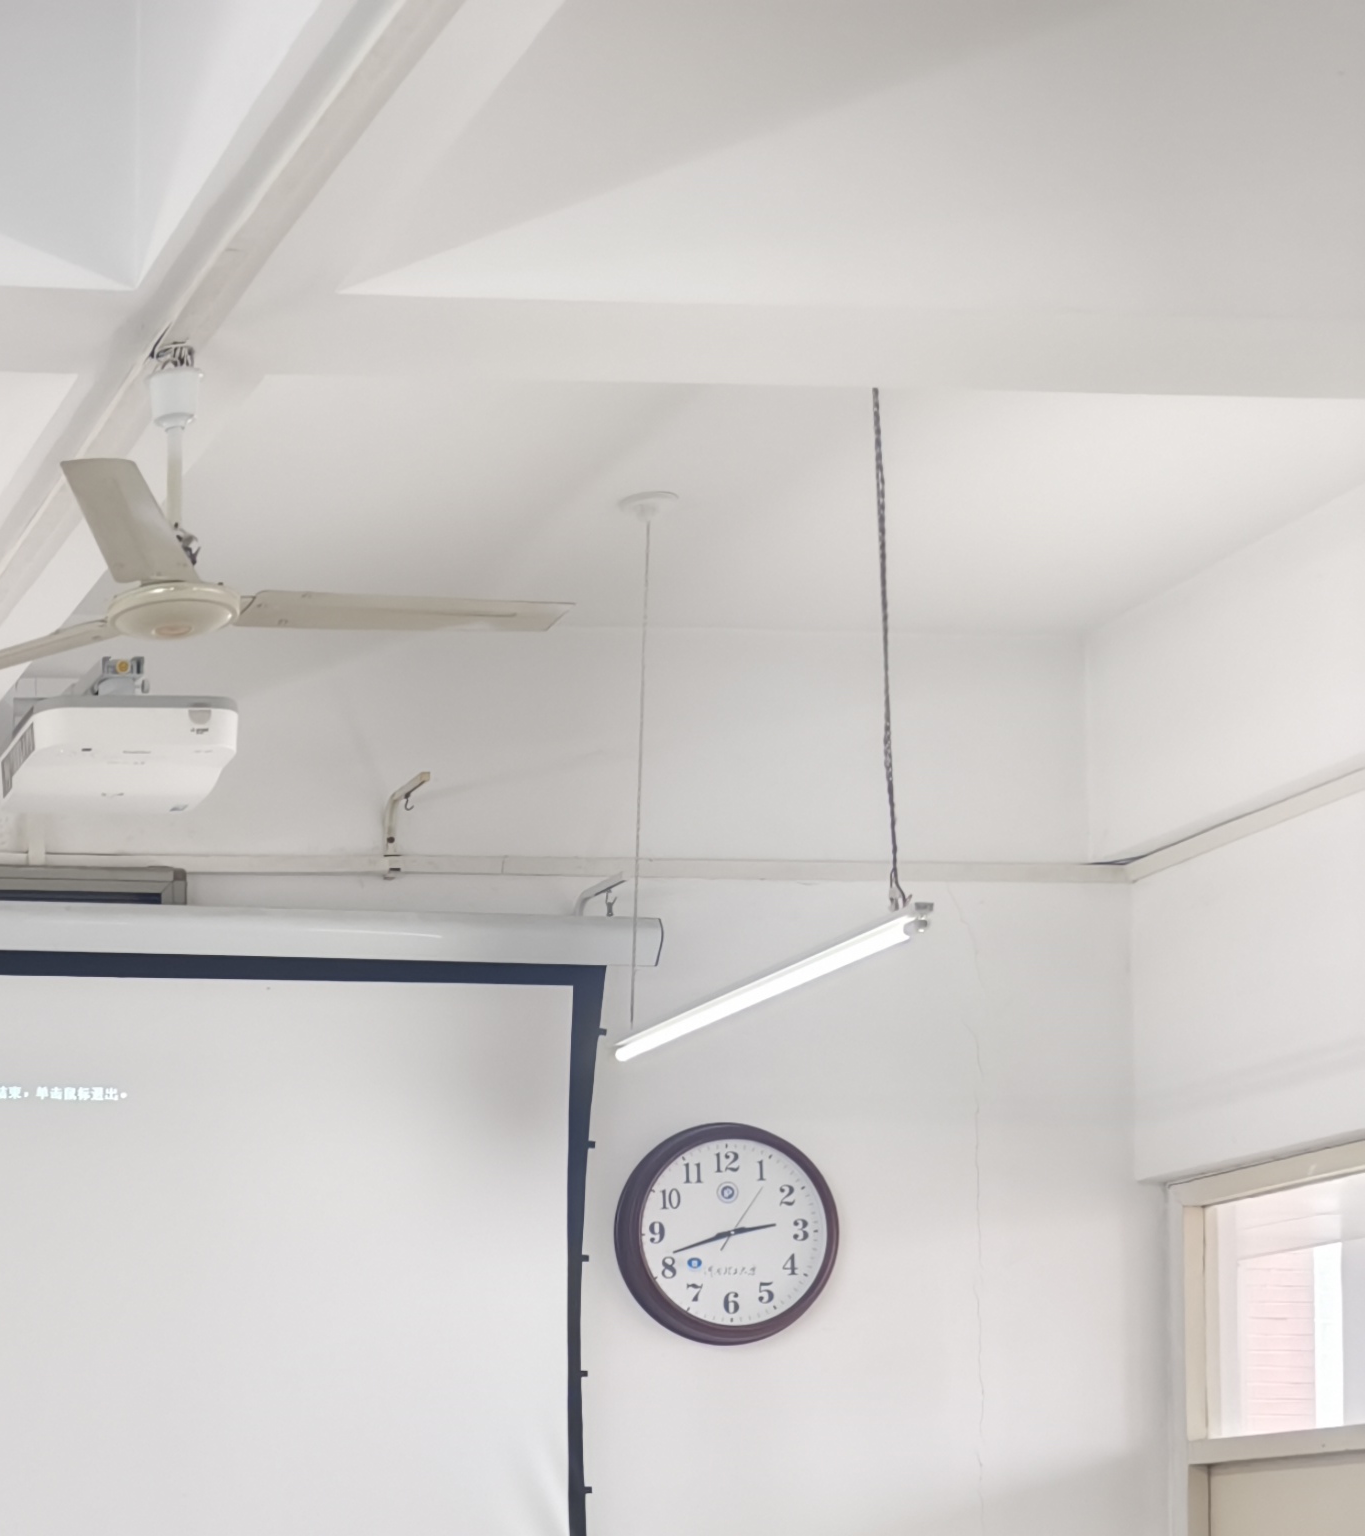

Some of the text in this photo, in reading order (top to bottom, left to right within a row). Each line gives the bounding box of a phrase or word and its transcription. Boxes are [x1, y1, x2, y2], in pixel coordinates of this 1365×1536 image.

[683, 1162, 703, 1184] 11
[714, 1151, 740, 1173] 12
[757, 1159, 767, 1181] 1
[660, 1188, 681, 1210] 10
[779, 1184, 796, 1206] 2
[648, 1221, 666, 1244] 9
[792, 1218, 809, 1242] 3
[661, 1256, 677, 1279] 8
[782, 1253, 799, 1276] 4
[686, 1283, 703, 1302] 7
[723, 1292, 740, 1314] 6
[758, 1281, 775, 1304] 5
